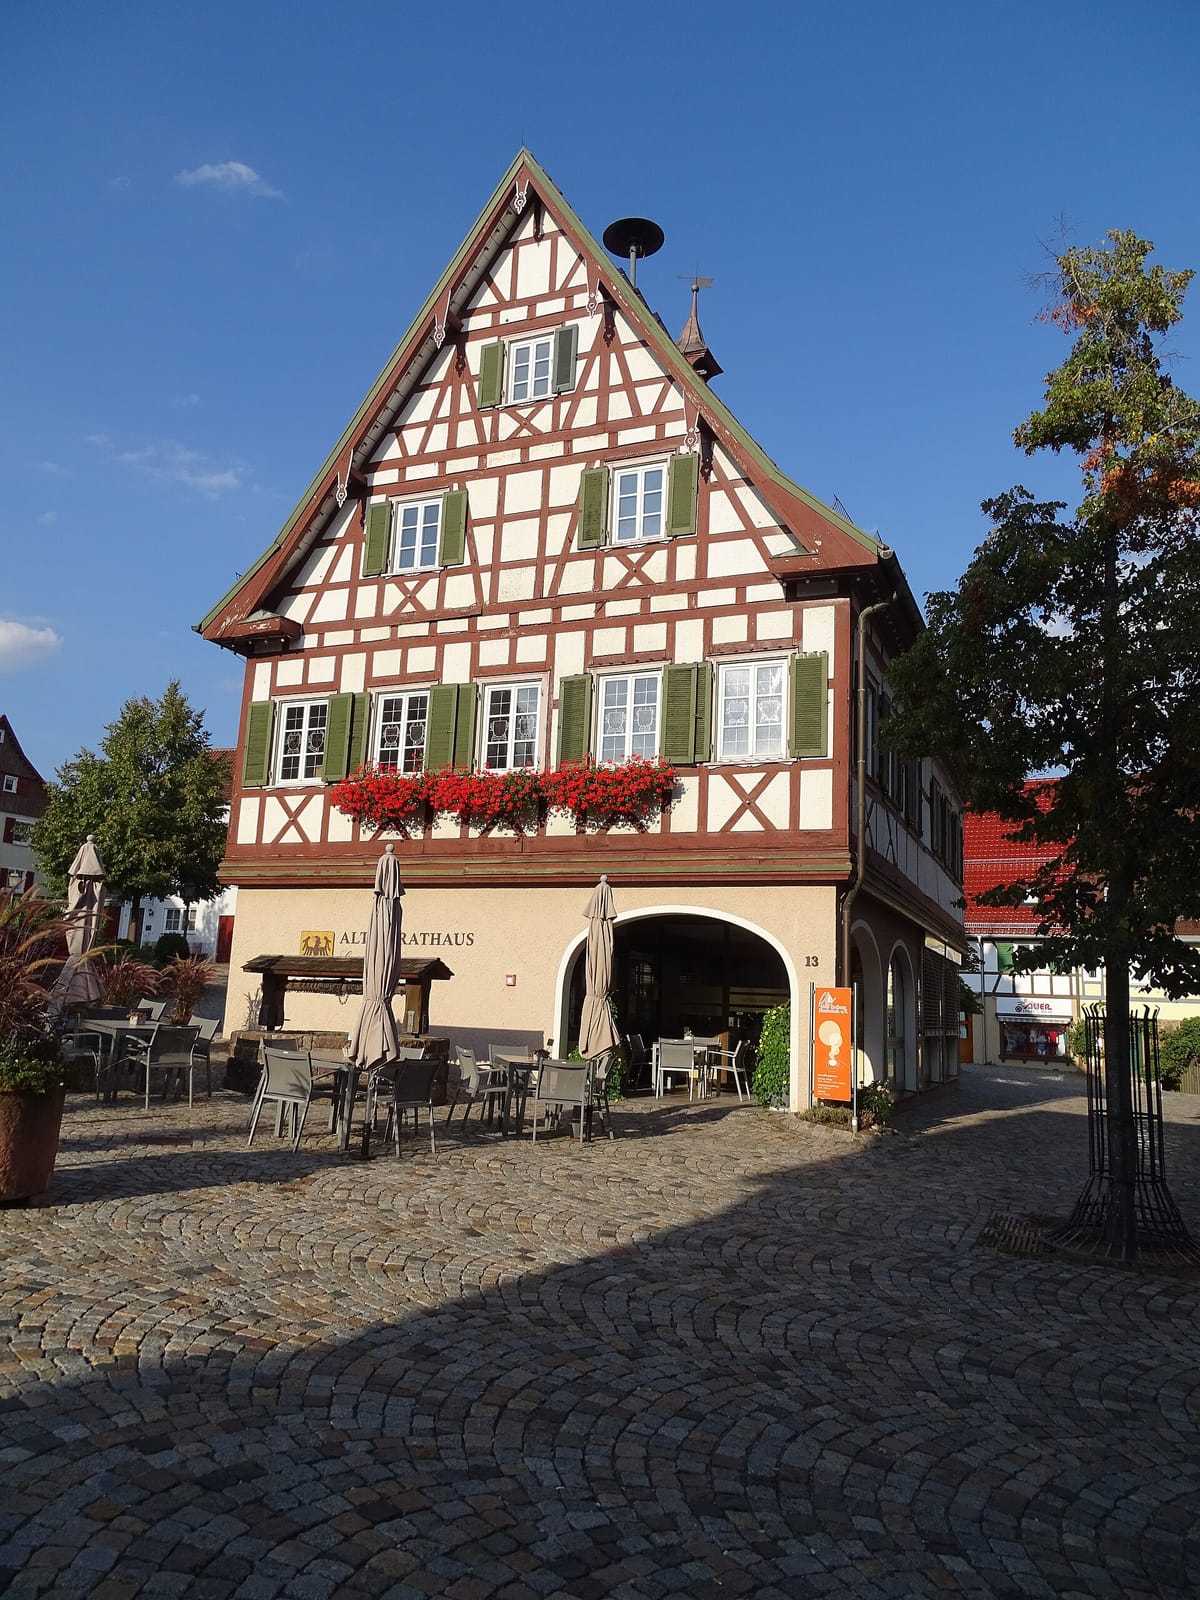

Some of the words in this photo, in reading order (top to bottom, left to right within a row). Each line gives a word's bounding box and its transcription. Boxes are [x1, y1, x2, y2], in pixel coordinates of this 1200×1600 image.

[339, 931, 369, 945] ALT
[400, 932, 475, 946] RATHAUS
[804, 955, 820, 968] 13
